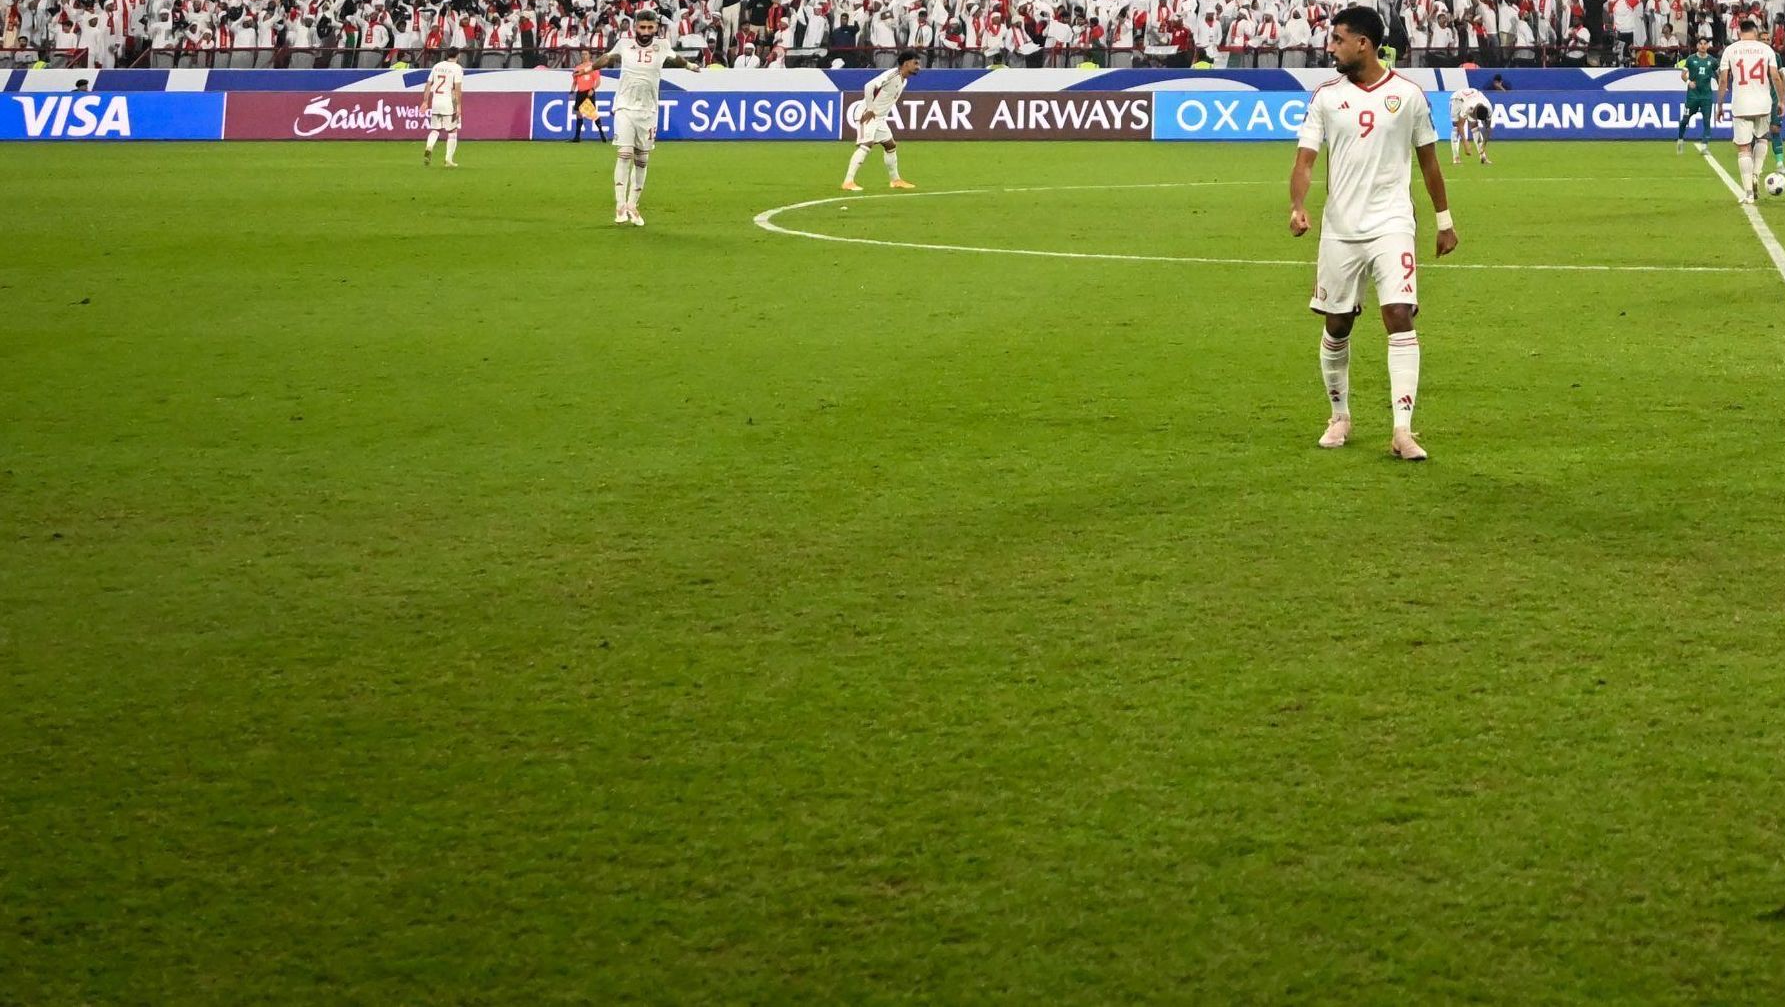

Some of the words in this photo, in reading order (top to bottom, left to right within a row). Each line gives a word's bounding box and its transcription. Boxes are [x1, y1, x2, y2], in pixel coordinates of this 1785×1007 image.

[637, 50, 652, 63] 15
[435, 75, 447, 94] 2
[1736, 58, 1765, 86] 14
[12, 95, 131, 137] VISA
[294, 96, 394, 137] Saudi
[405, 119, 419, 130] to
[541, 99, 679, 132] CRET
[689, 99, 834, 132] SAISON
[989, 99, 1149, 130] AIRWAYS
[1176, 99, 1306, 131] OXAG
[1359, 110, 1374, 138] 9
[1490, 103, 1584, 129] ASIAN
[1401, 252, 1415, 281] 9
